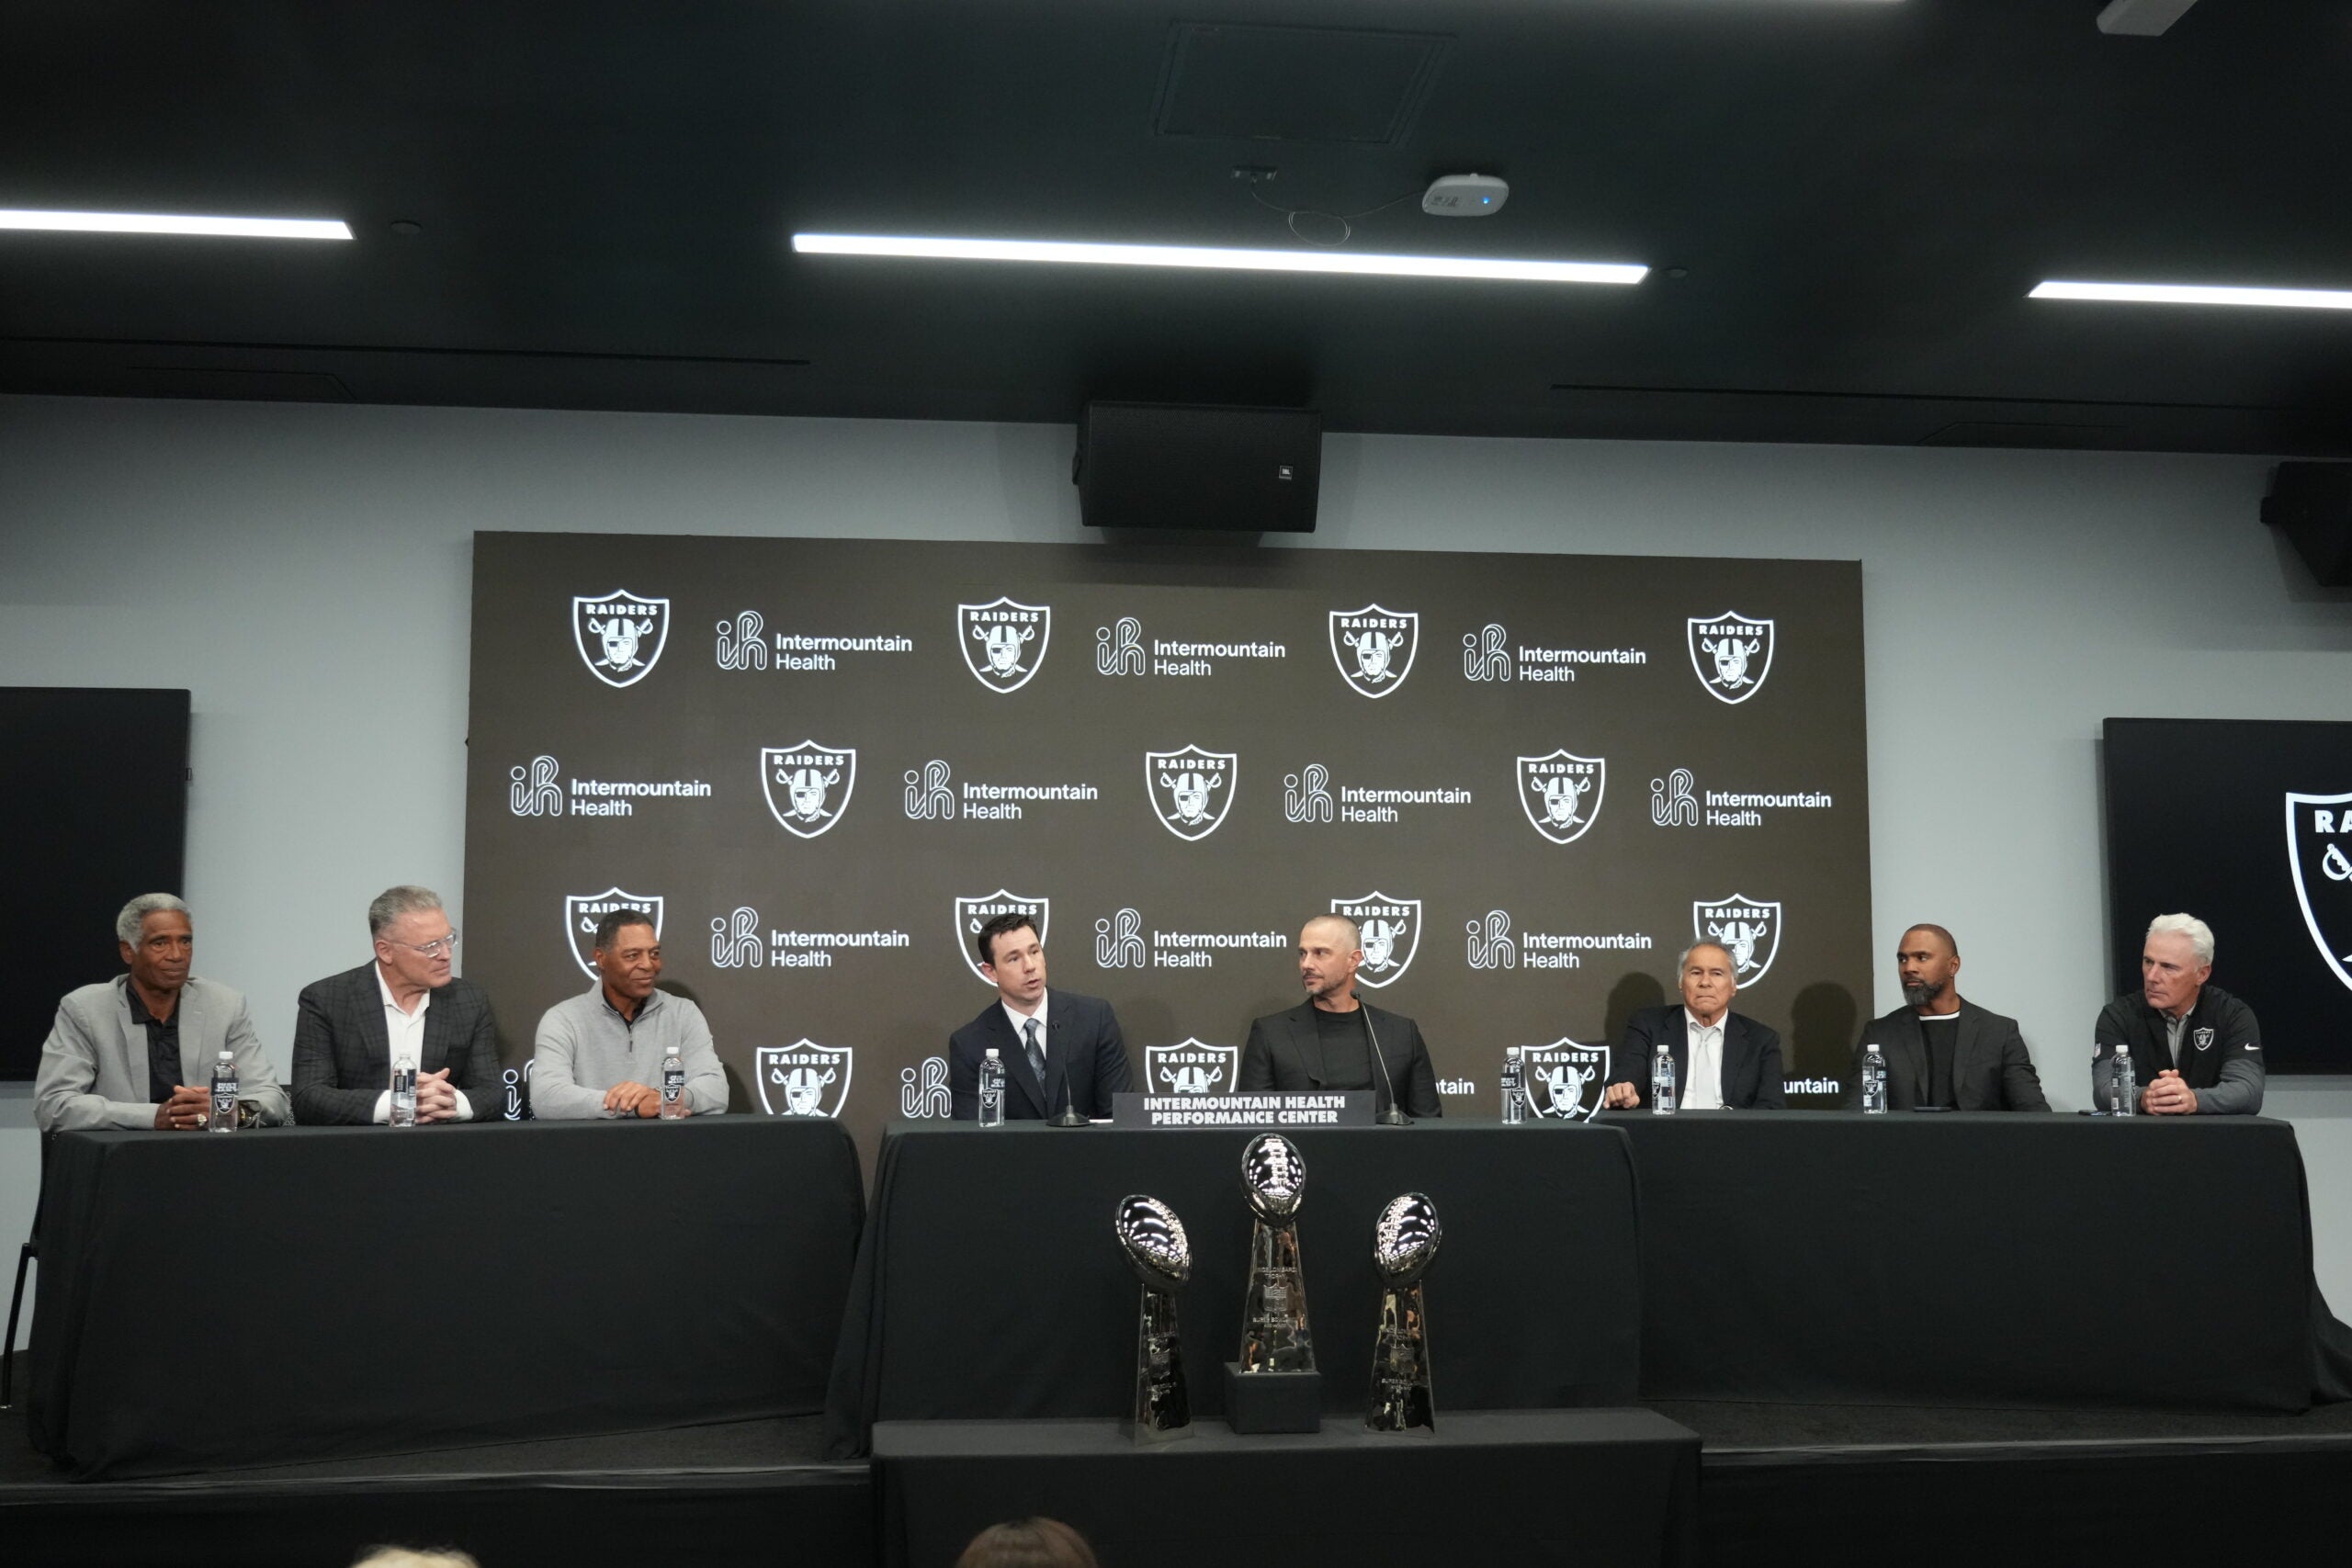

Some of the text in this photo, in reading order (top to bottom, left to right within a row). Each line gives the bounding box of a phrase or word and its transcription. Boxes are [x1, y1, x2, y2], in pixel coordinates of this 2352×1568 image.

[586, 604, 658, 615] RAIDERS
[970, 611, 1039, 623] RAIDERS
[1340, 617, 1408, 629] RAIDERS
[1699, 625, 1763, 636] RAIDERS
[776, 633, 912, 652] Intermountain
[1154, 638, 1286, 658] Intermountain
[775, 653, 836, 671] Health
[1519, 645, 1646, 664] Intermountain
[1154, 659, 1212, 676] Health
[1519, 665, 1575, 682] Health
[774, 754, 844, 766] RAIDERS
[1158, 759, 1226, 770] RAIDERS
[1528, 763, 1594, 774] RAIDERS
[571, 778, 712, 797] Intermountain
[963, 782, 1098, 800] Intermountain
[1341, 785, 1472, 804] Intermountain
[571, 798, 633, 817] Health
[1705, 790, 1832, 808] Intermountain
[963, 802, 1023, 819] Health
[1341, 806, 1398, 823] Health
[1706, 809, 1762, 827] Health
[967, 904, 1037, 915] RAIDERS
[1342, 906, 1410, 917] RAIDERS
[1704, 908, 1770, 919] RAIDERS
[771, 929, 910, 947] Intermountain
[1154, 930, 1287, 948] Intermountain
[1522, 931, 1652, 950] Intermountain
[771, 950, 831, 967] Health
[1154, 950, 1213, 968] Health
[1523, 952, 1580, 969] Health
[769, 1054, 841, 1065] RAIDERS
[1158, 1052, 1227, 1064] RAIDERS
[1532, 1052, 1599, 1063] RAIDERS
[1144, 1095, 1346, 1111] INTERMOUNTAIN HEALTH
[1151, 1110, 1339, 1125] PERFORMANCE CENTER
